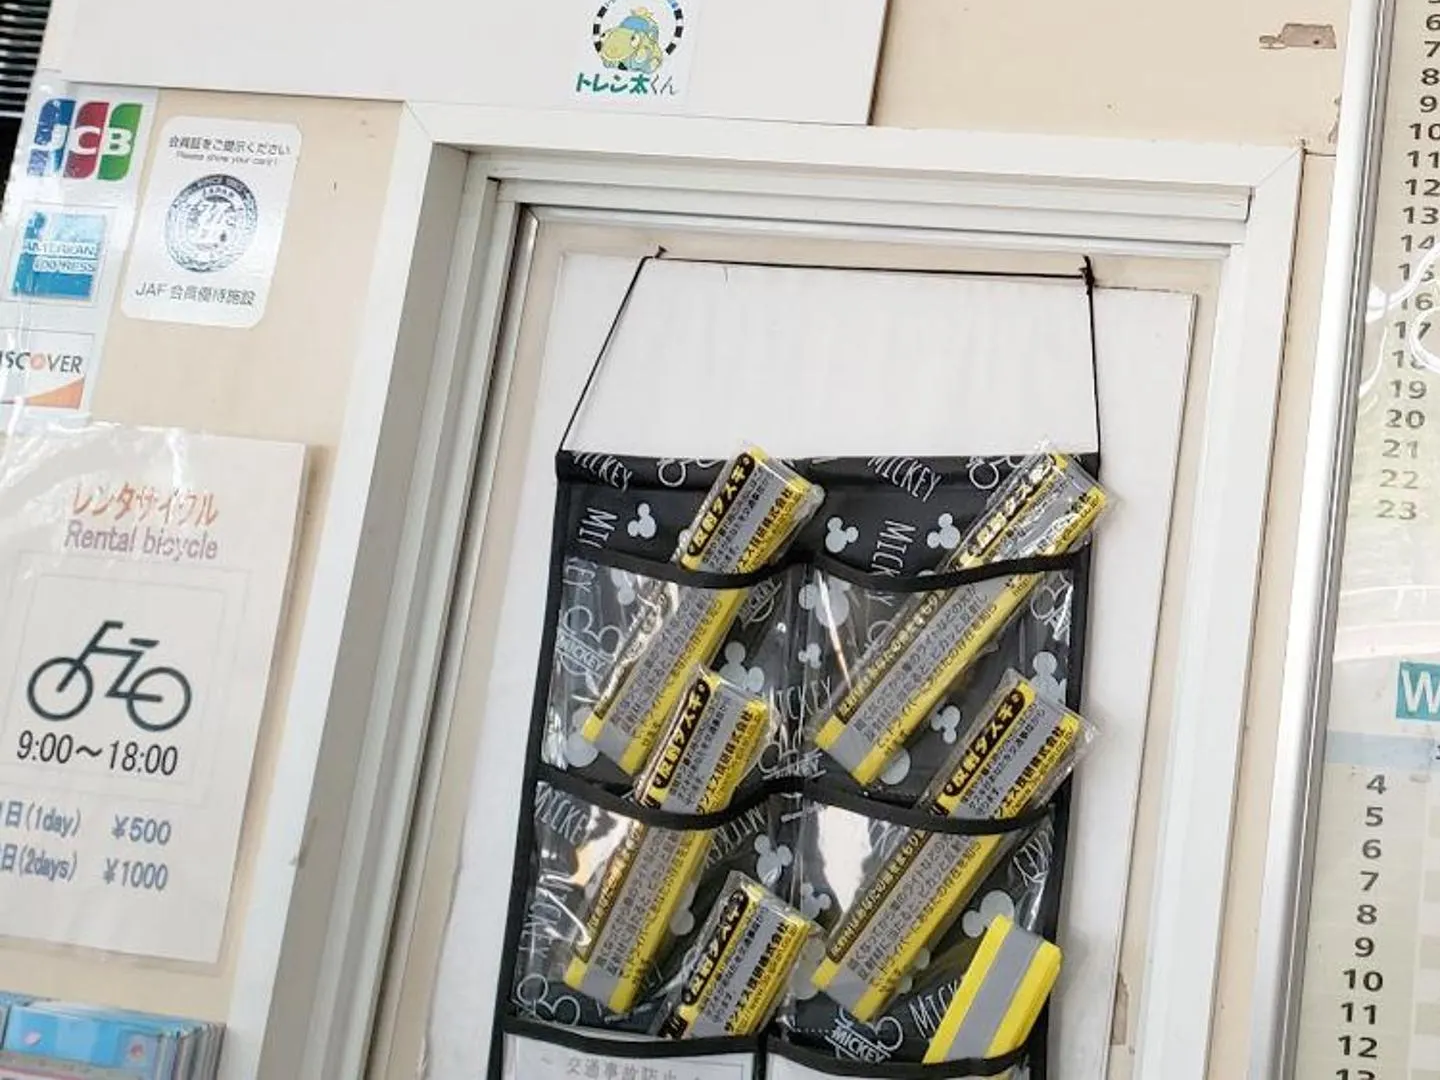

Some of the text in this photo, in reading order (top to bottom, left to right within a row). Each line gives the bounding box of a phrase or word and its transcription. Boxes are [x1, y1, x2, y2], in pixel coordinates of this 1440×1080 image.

[1424, 41, 1440, 58] 7
[575, 72, 678, 96] トレン太くん
[1422, 68, 1440, 85] 8
[1420, 96, 1437, 113] 9
[1407, 151, 1440, 168] 11
[1405, 179, 1440, 196] 12
[1403, 207, 1439, 224] 13
[136, 282, 168, 298] JAF
[72, 481, 220, 527] レンタサイクル
[64, 520, 219, 562] Rental bicycle
[1366, 774, 1386, 794] 4
[1366, 807, 1383, 827] 5
[1363, 839, 1381, 859] 6
[1360, 872, 1379, 891] 7
[1357, 904, 1377, 924] 8
[1355, 937, 1374, 958] 9
[1344, 969, 1383, 992] 10
[1341, 1003, 1376, 1025] 11
[830, 1027, 887, 1064] MICKEY
[1338, 1036, 1377, 1059] 12
